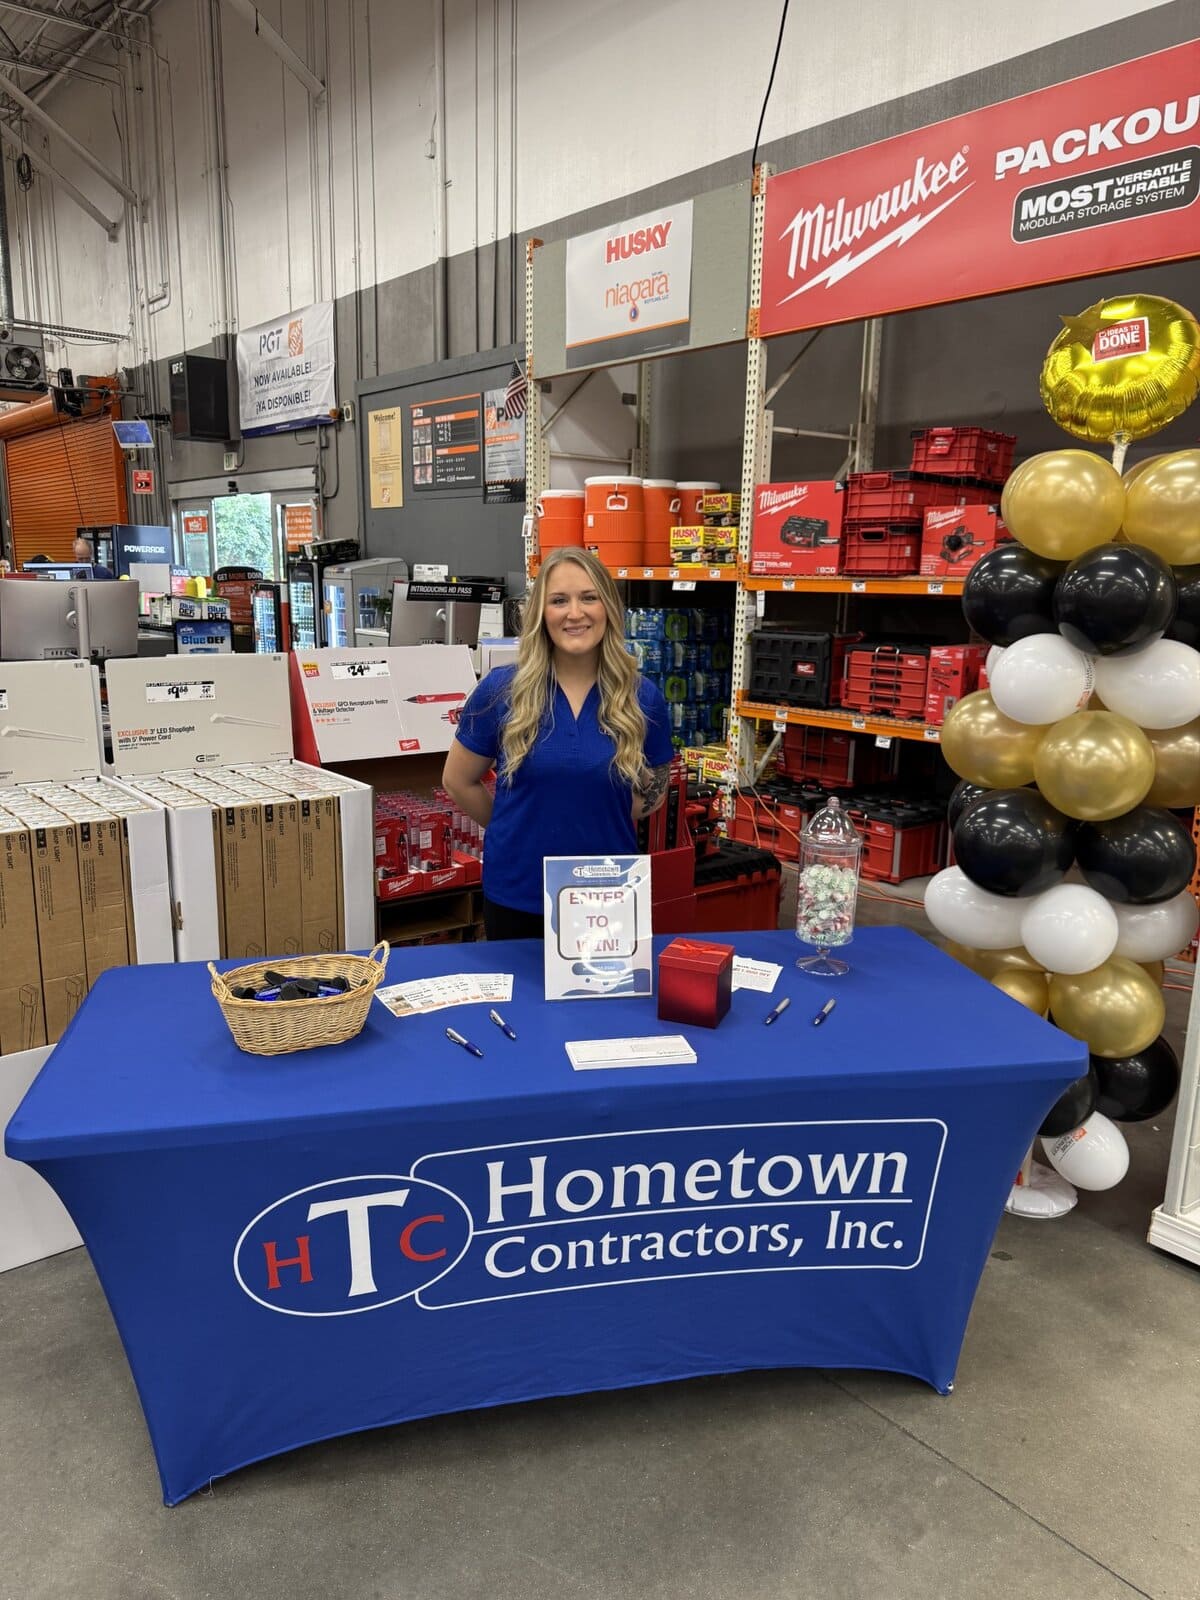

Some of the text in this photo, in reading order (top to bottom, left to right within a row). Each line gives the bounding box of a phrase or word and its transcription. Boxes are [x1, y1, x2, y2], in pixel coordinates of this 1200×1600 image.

[995, 95, 1200, 180] PACKOU
[1113, 171, 1191, 199] DURABLE
[1115, 159, 1192, 185] VERSATILE
[1019, 185, 1185, 231] MODULAR STORAGE SYSTEM
[1021, 178, 1114, 220] MOST
[779, 147, 969, 279] Milwaukee
[606, 220, 673, 264] HUSKY
[606, 273, 669, 308] niagara
[259, 328, 283, 356] PGT
[1100, 331, 1140, 350] DONE
[1107, 324, 1140, 337] IDEAS TO
[254, 361, 312, 387] NOW AVAILABLE!
[267, 389, 311, 410] DISPONIBLE!
[705, 496, 728, 505] HUSKY
[758, 485, 809, 510] Milwaukee
[673, 529, 699, 538] HUSKY
[410, 585, 448, 593] INTRODUCING
[117, 728, 148, 737] EXCLUSIVE
[169, 725, 195, 734] Shoplight
[586, 915, 608, 928] TO
[486, 1148, 908, 1224] Hometown
[484, 1210, 904, 1279] Contractors, Inc.
